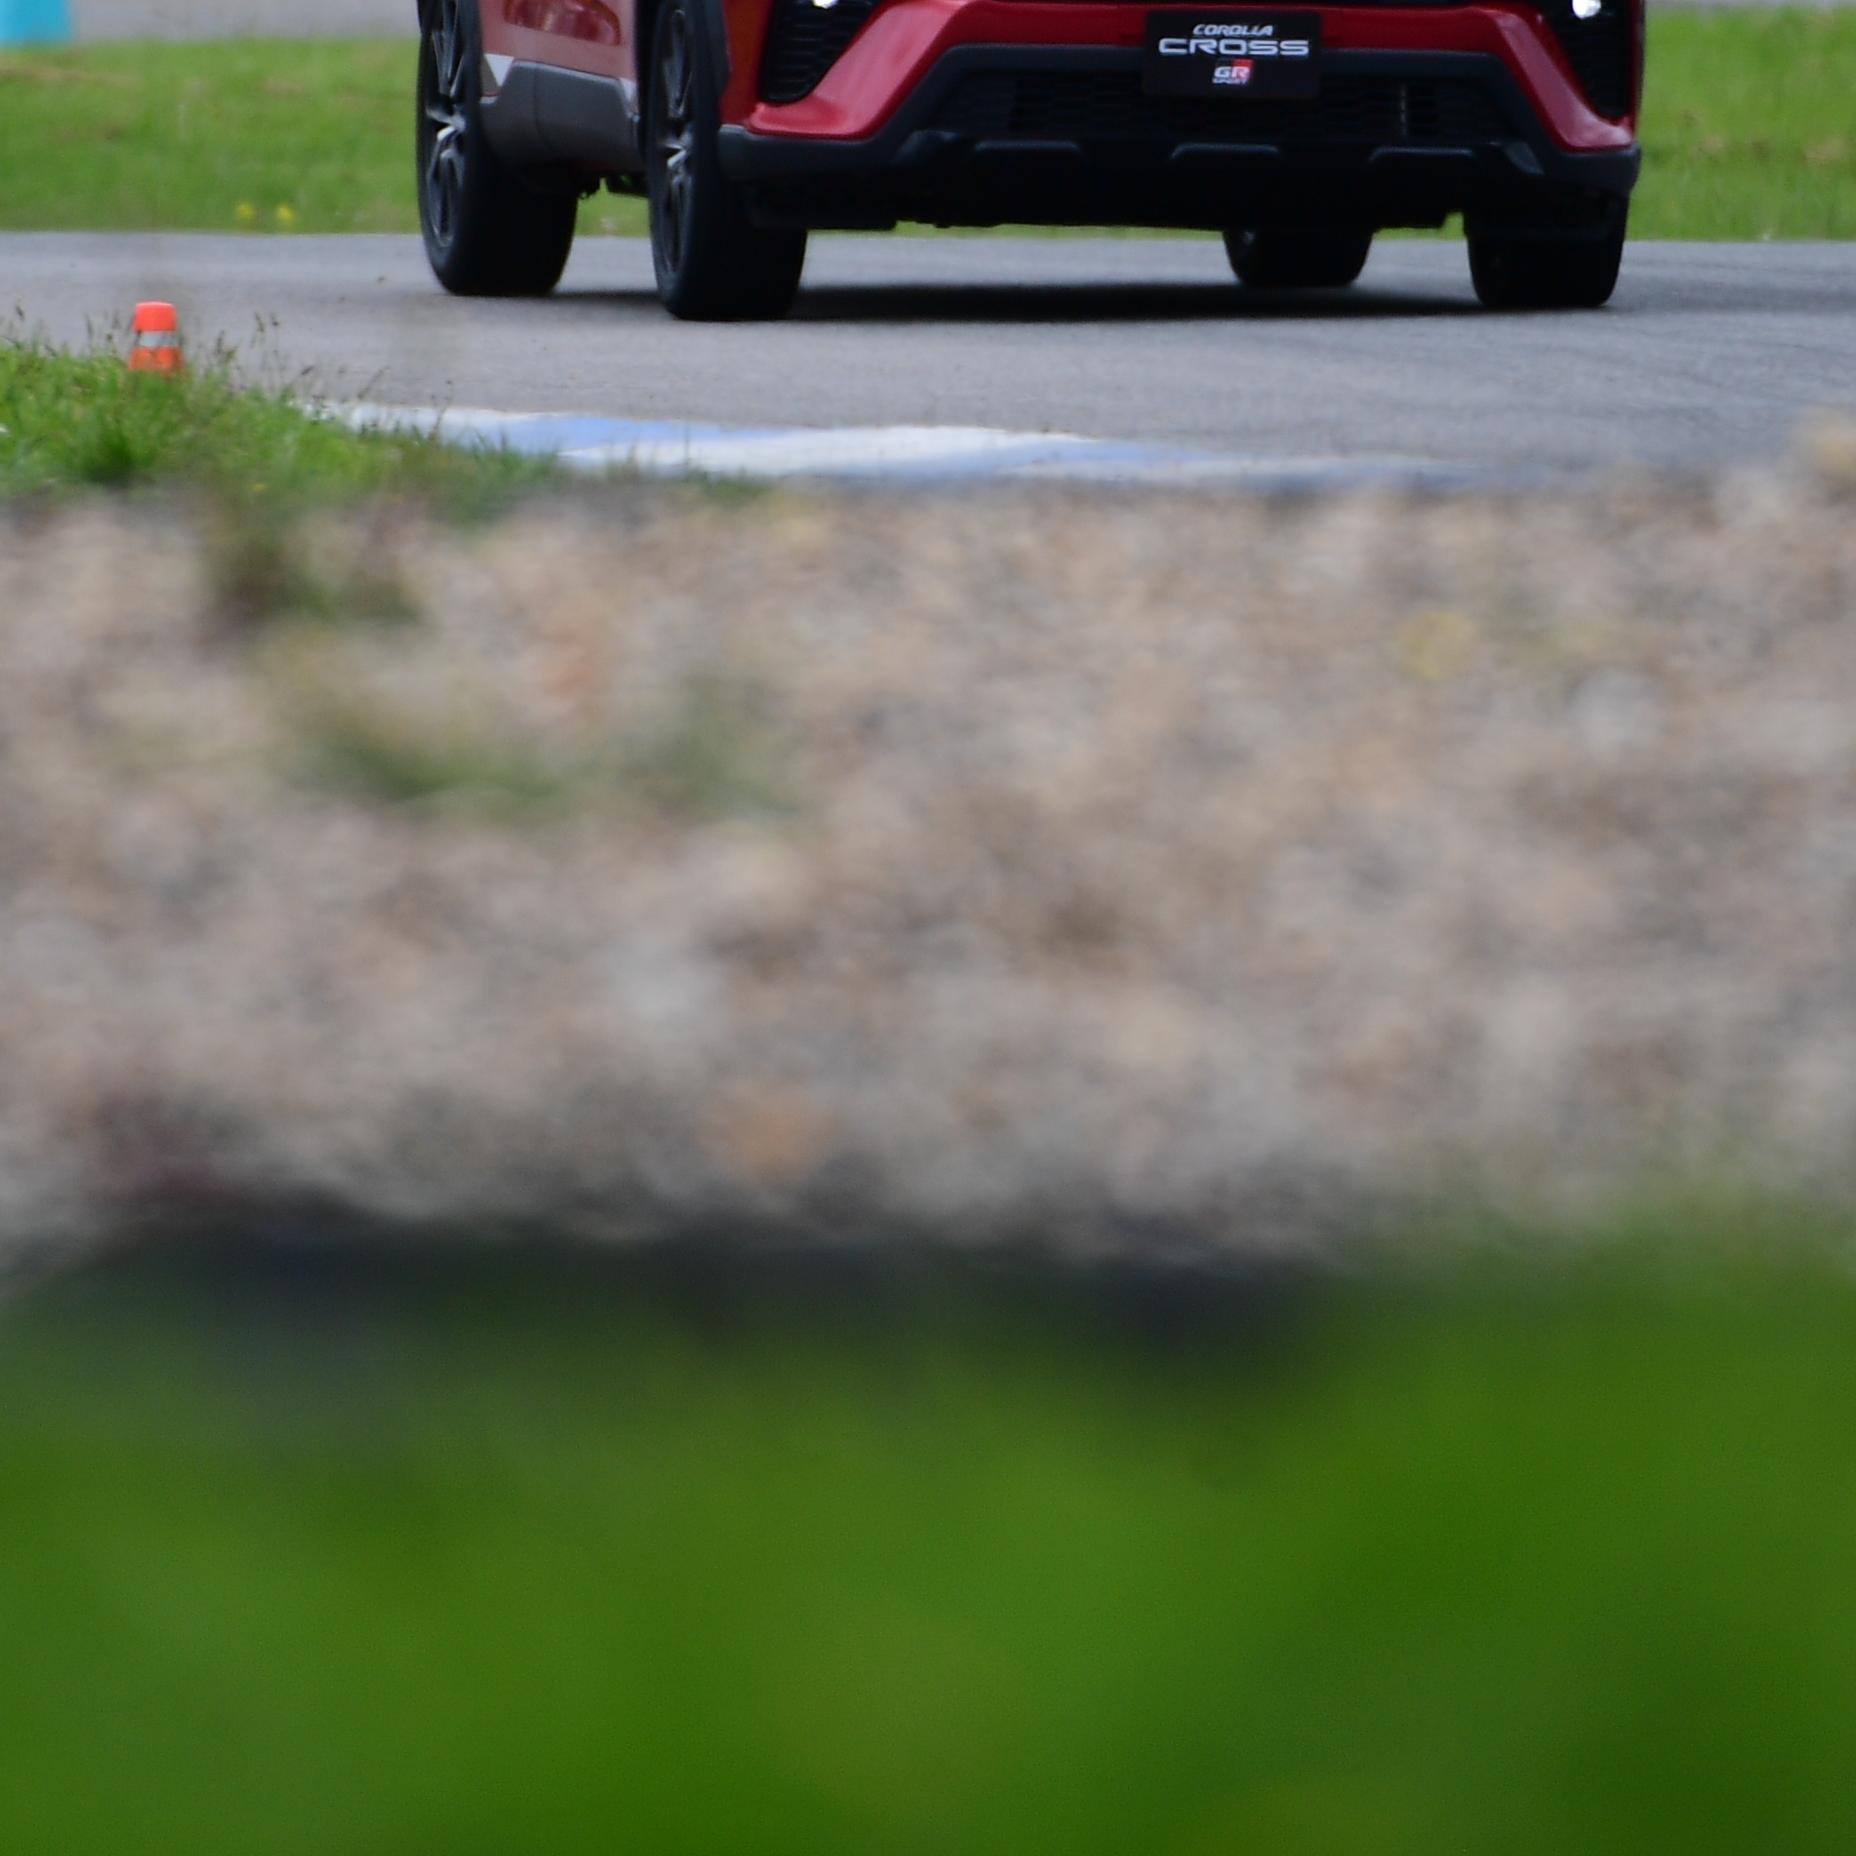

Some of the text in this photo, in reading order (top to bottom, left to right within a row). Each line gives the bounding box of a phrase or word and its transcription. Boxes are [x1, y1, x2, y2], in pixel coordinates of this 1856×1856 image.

[1192, 24, 1274, 36] COROLLA
[1158, 38, 1310, 56] CROSS
[1214, 66, 1250, 78] GR
